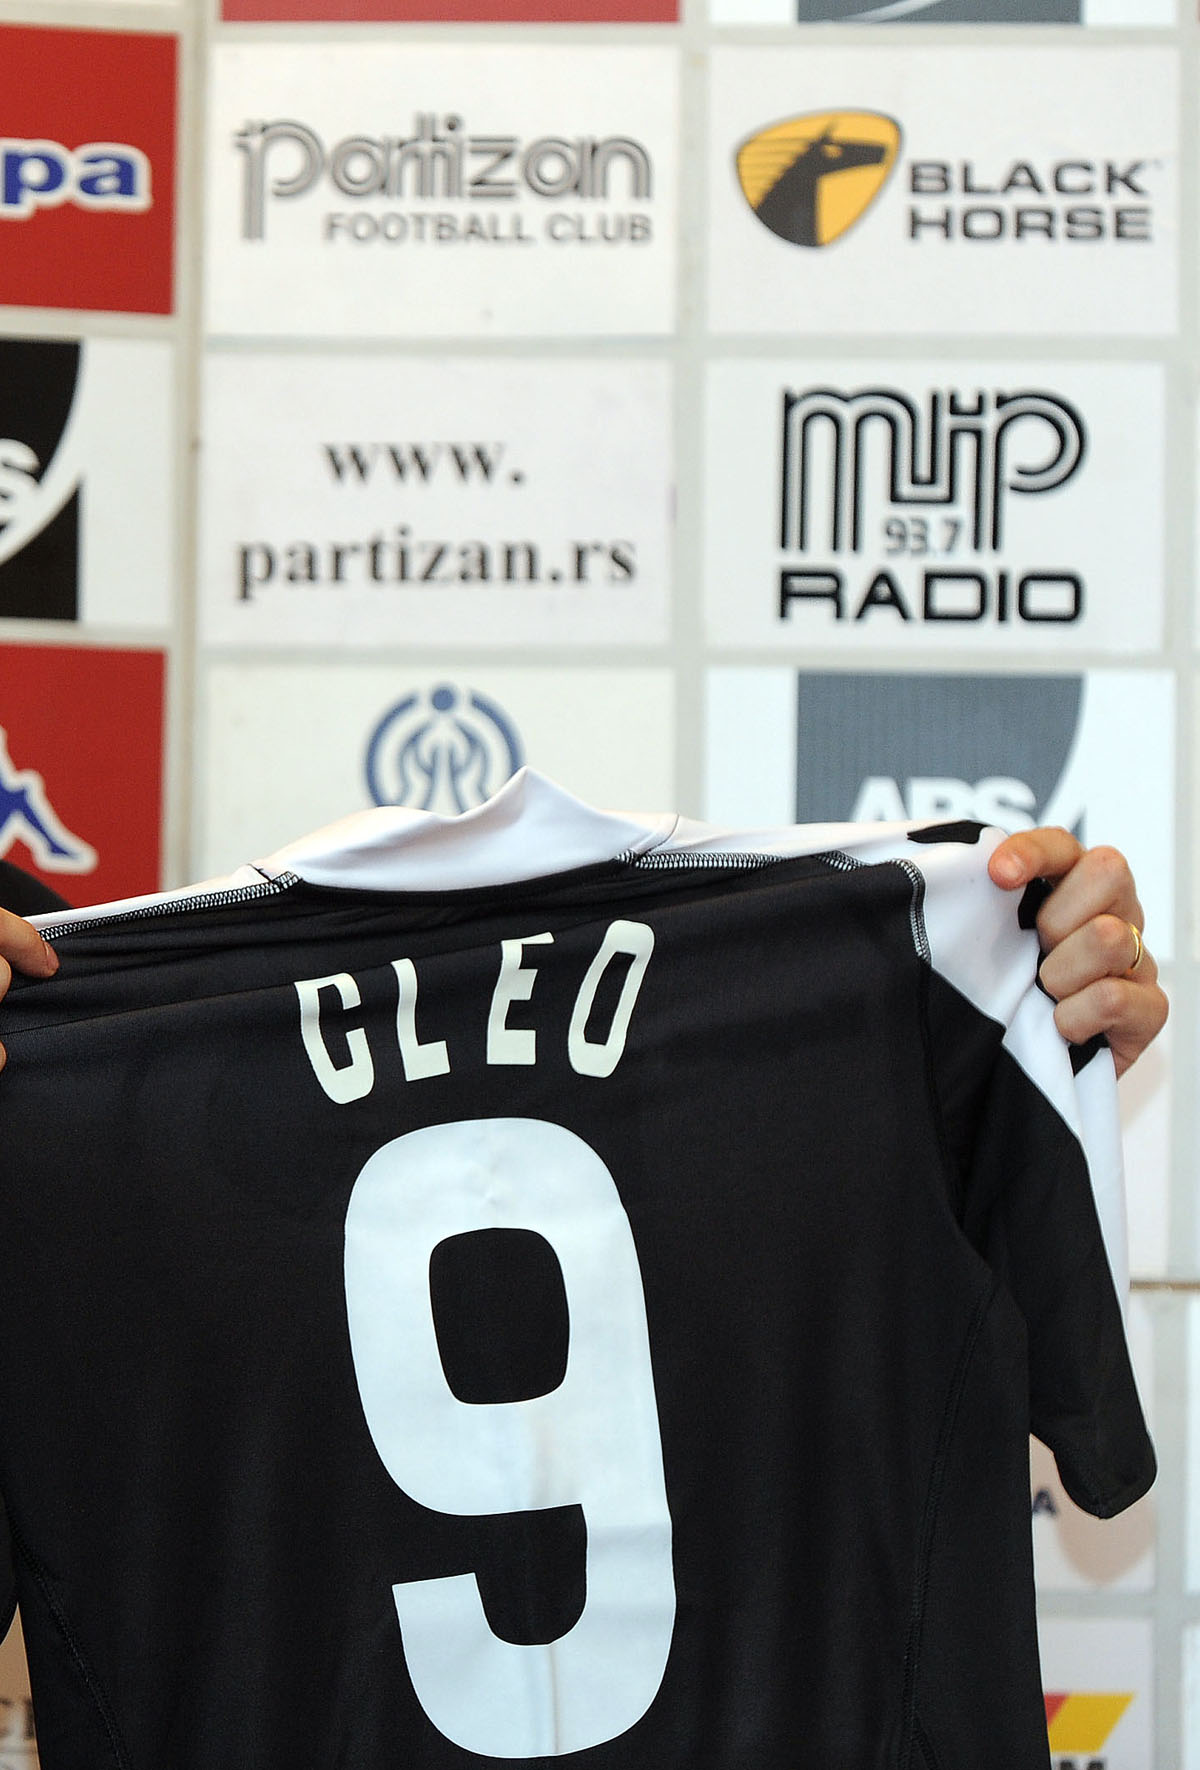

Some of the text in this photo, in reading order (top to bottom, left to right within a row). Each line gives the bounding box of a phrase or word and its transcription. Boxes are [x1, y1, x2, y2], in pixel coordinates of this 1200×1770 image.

[235, 112, 653, 241] partizan
[909, 161, 1146, 195] BLACK
[324, 212, 653, 243] FOOTBALL CLUB
[909, 206, 1152, 241] HORSE
[323, 442, 526, 486] www.
[884, 517, 963, 555] 93.7
[237, 526, 637, 603] partizan.rs
[780, 570, 1084, 623] RADIO
[293, 919, 655, 1105] CLEO
[343, 1116, 677, 1758] 9
